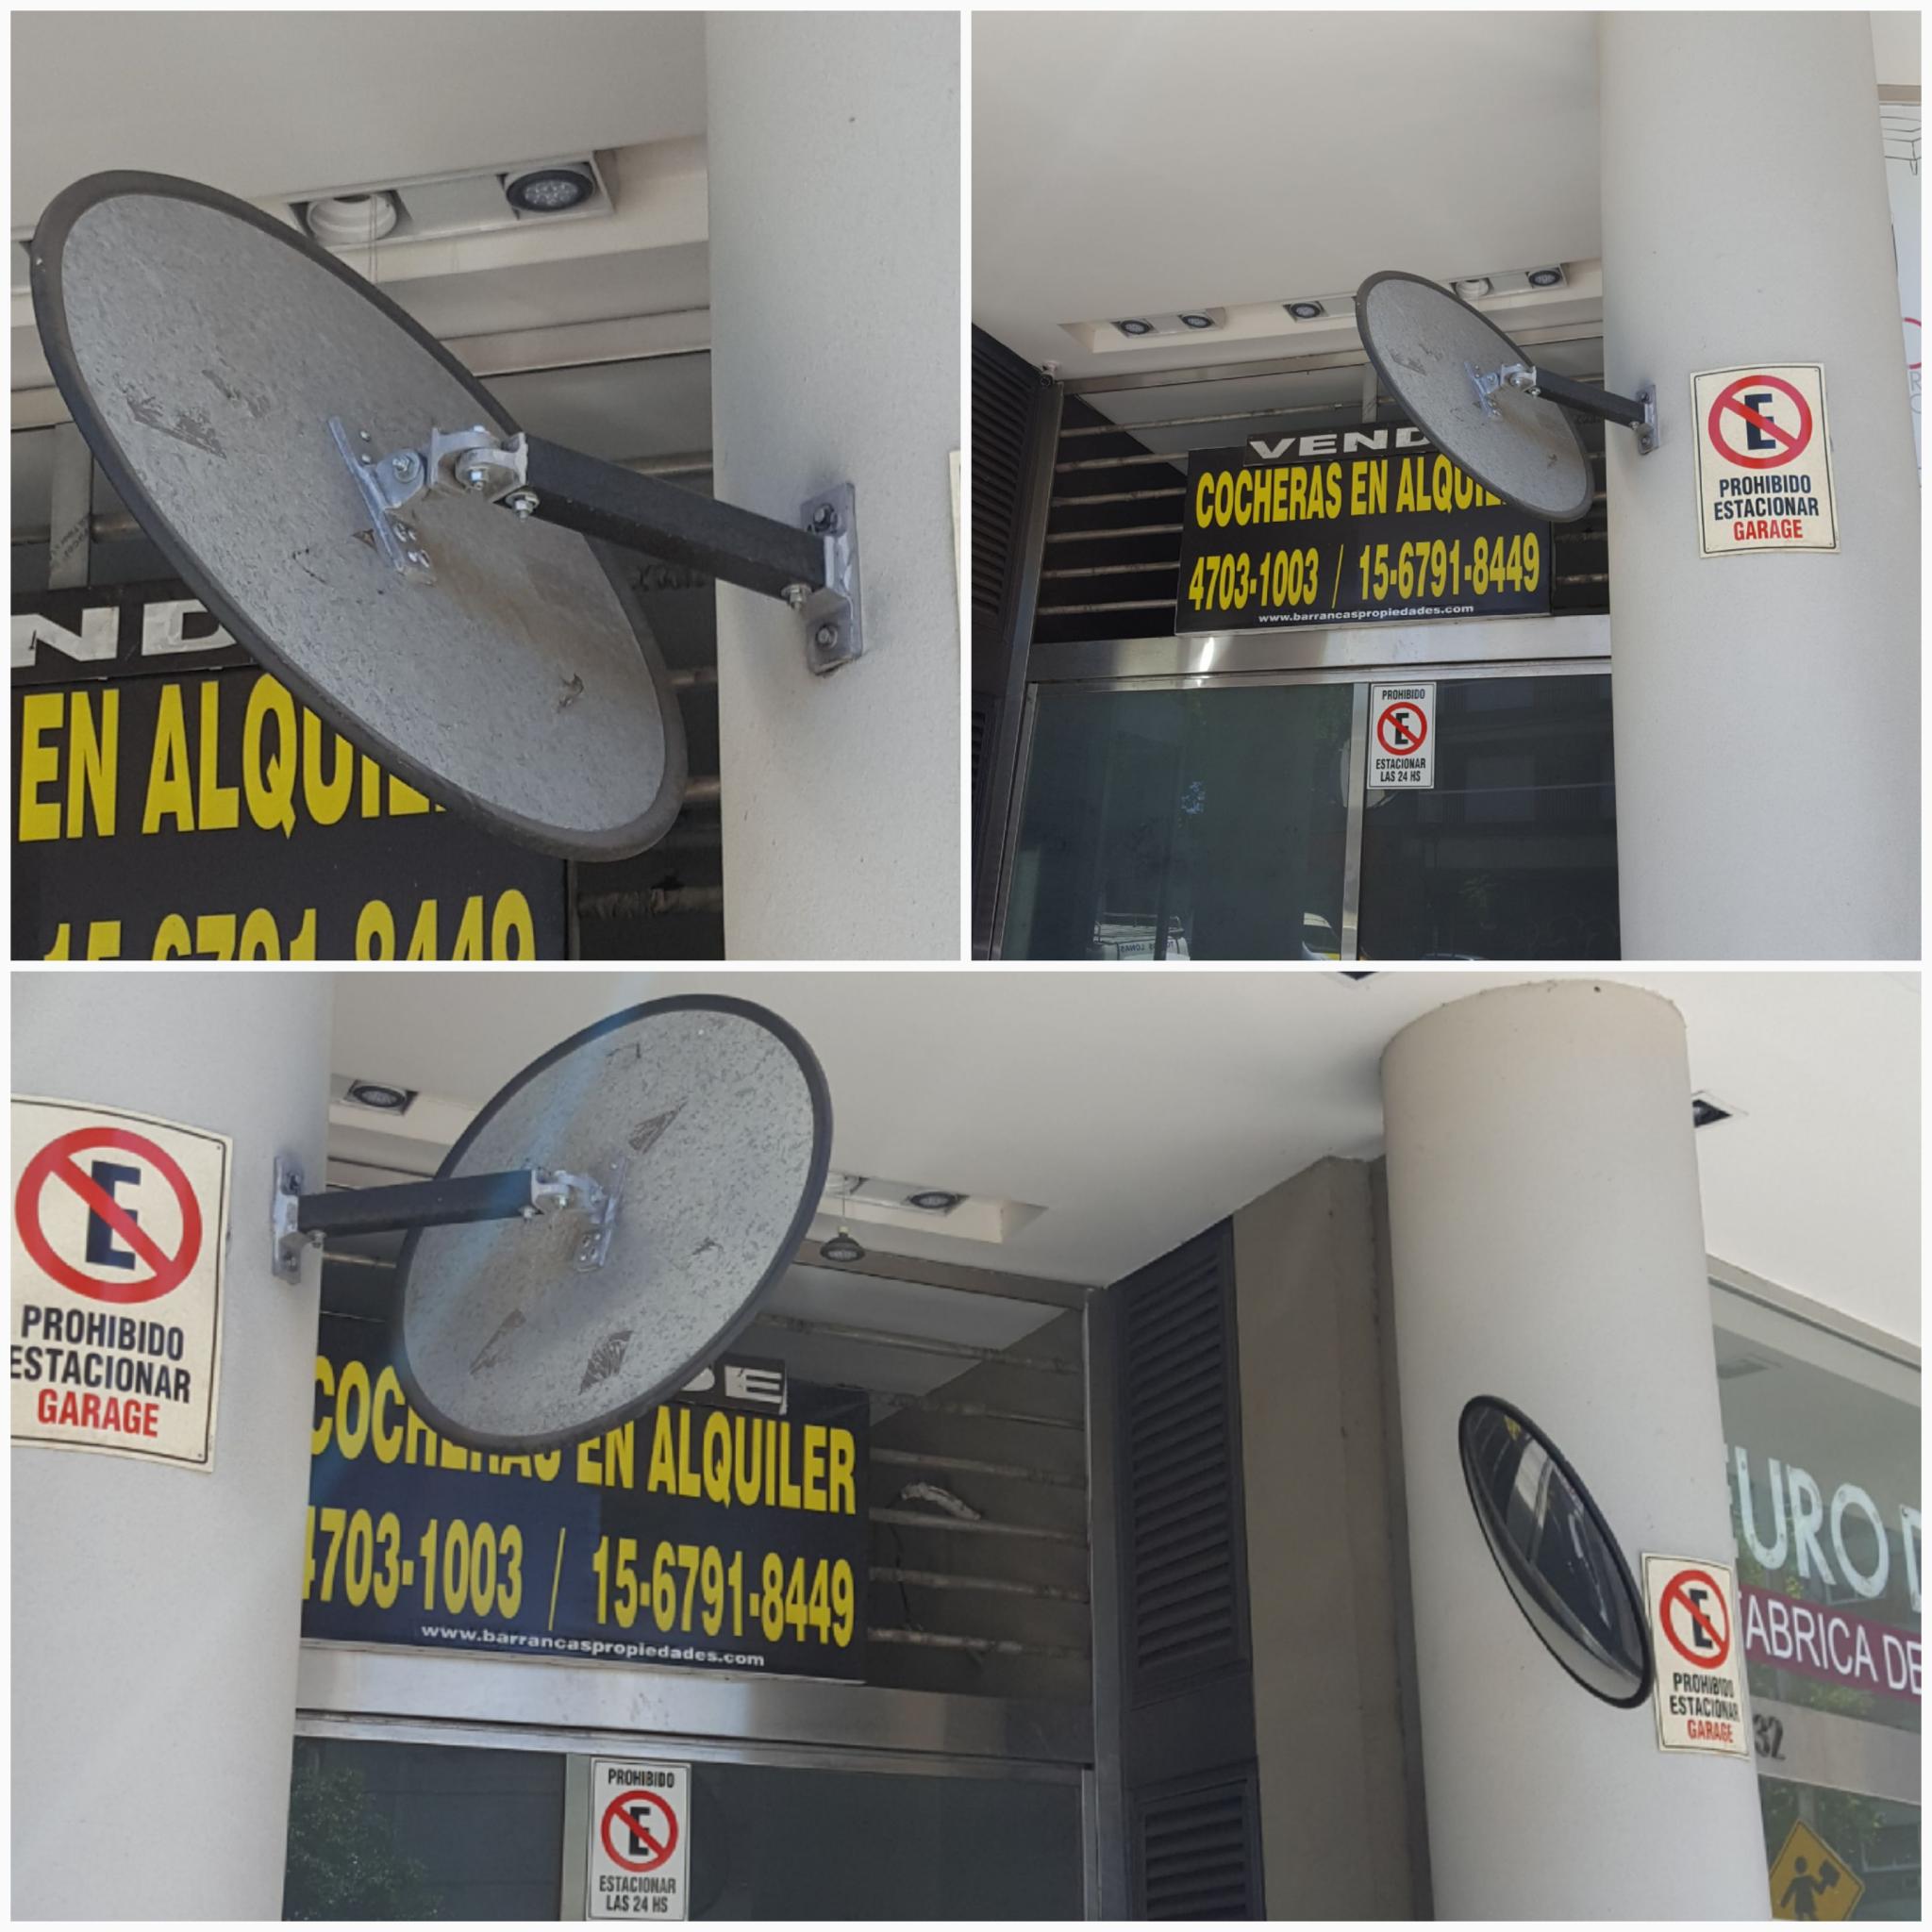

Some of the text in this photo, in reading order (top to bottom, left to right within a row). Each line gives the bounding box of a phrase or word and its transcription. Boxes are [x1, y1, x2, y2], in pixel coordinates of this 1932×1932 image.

[1744, 393, 1776, 450] E
[1196, 461, 1342, 528] COCHERAS
[1350, 458, 1388, 516] EN
[1719, 475, 1811, 498] PROHIBIDO
[1714, 497, 1819, 521] ESTACIONAR
[1733, 519, 1803, 541] GARAGE
[1189, 547, 1319, 611] 4703-1003
[1359, 532, 1541, 601] 15-6791-8449
[1258, 605, 1474, 623] www.barrancaspropiedades.com
[1382, 689, 1425, 700] PROHIBIDO
[1394, 712, 1409, 744] E
[19, 689, 119, 841] EN
[1376, 758, 1426, 770] ESTACIONAR
[1380, 771, 1421, 782] LAS 24 HS
[85, 1159, 141, 1270] E
[21, 1305, 184, 1361] PROHIBIDO
[11, 1344, 191, 1404] ESTACIONAR
[37, 1388, 159, 1437] GARAGE
[647, 1406, 856, 1514] ALQUILER
[1724, 1444, 1890, 1598] URO
[592, 1536, 855, 1647] 15-6791-8449
[1690, 1589, 1712, 1649] E
[1738, 1591, 1878, 1682] ABRICA
[421, 1624, 765, 1667] www.barrancaspropiedades.com
[1673, 1672, 1735, 1698] PROHIBIDO
[1670, 1695, 1740, 1723] ESTACIONAR
[1687, 1719, 1734, 1743] GARAGE
[608, 1769, 675, 1788] PROHIBIDO
[629, 1807, 651, 1856] E
[599, 1875, 676, 1894] ESTACIONAR
[607, 1895, 668, 1913] LAS 24 HS
